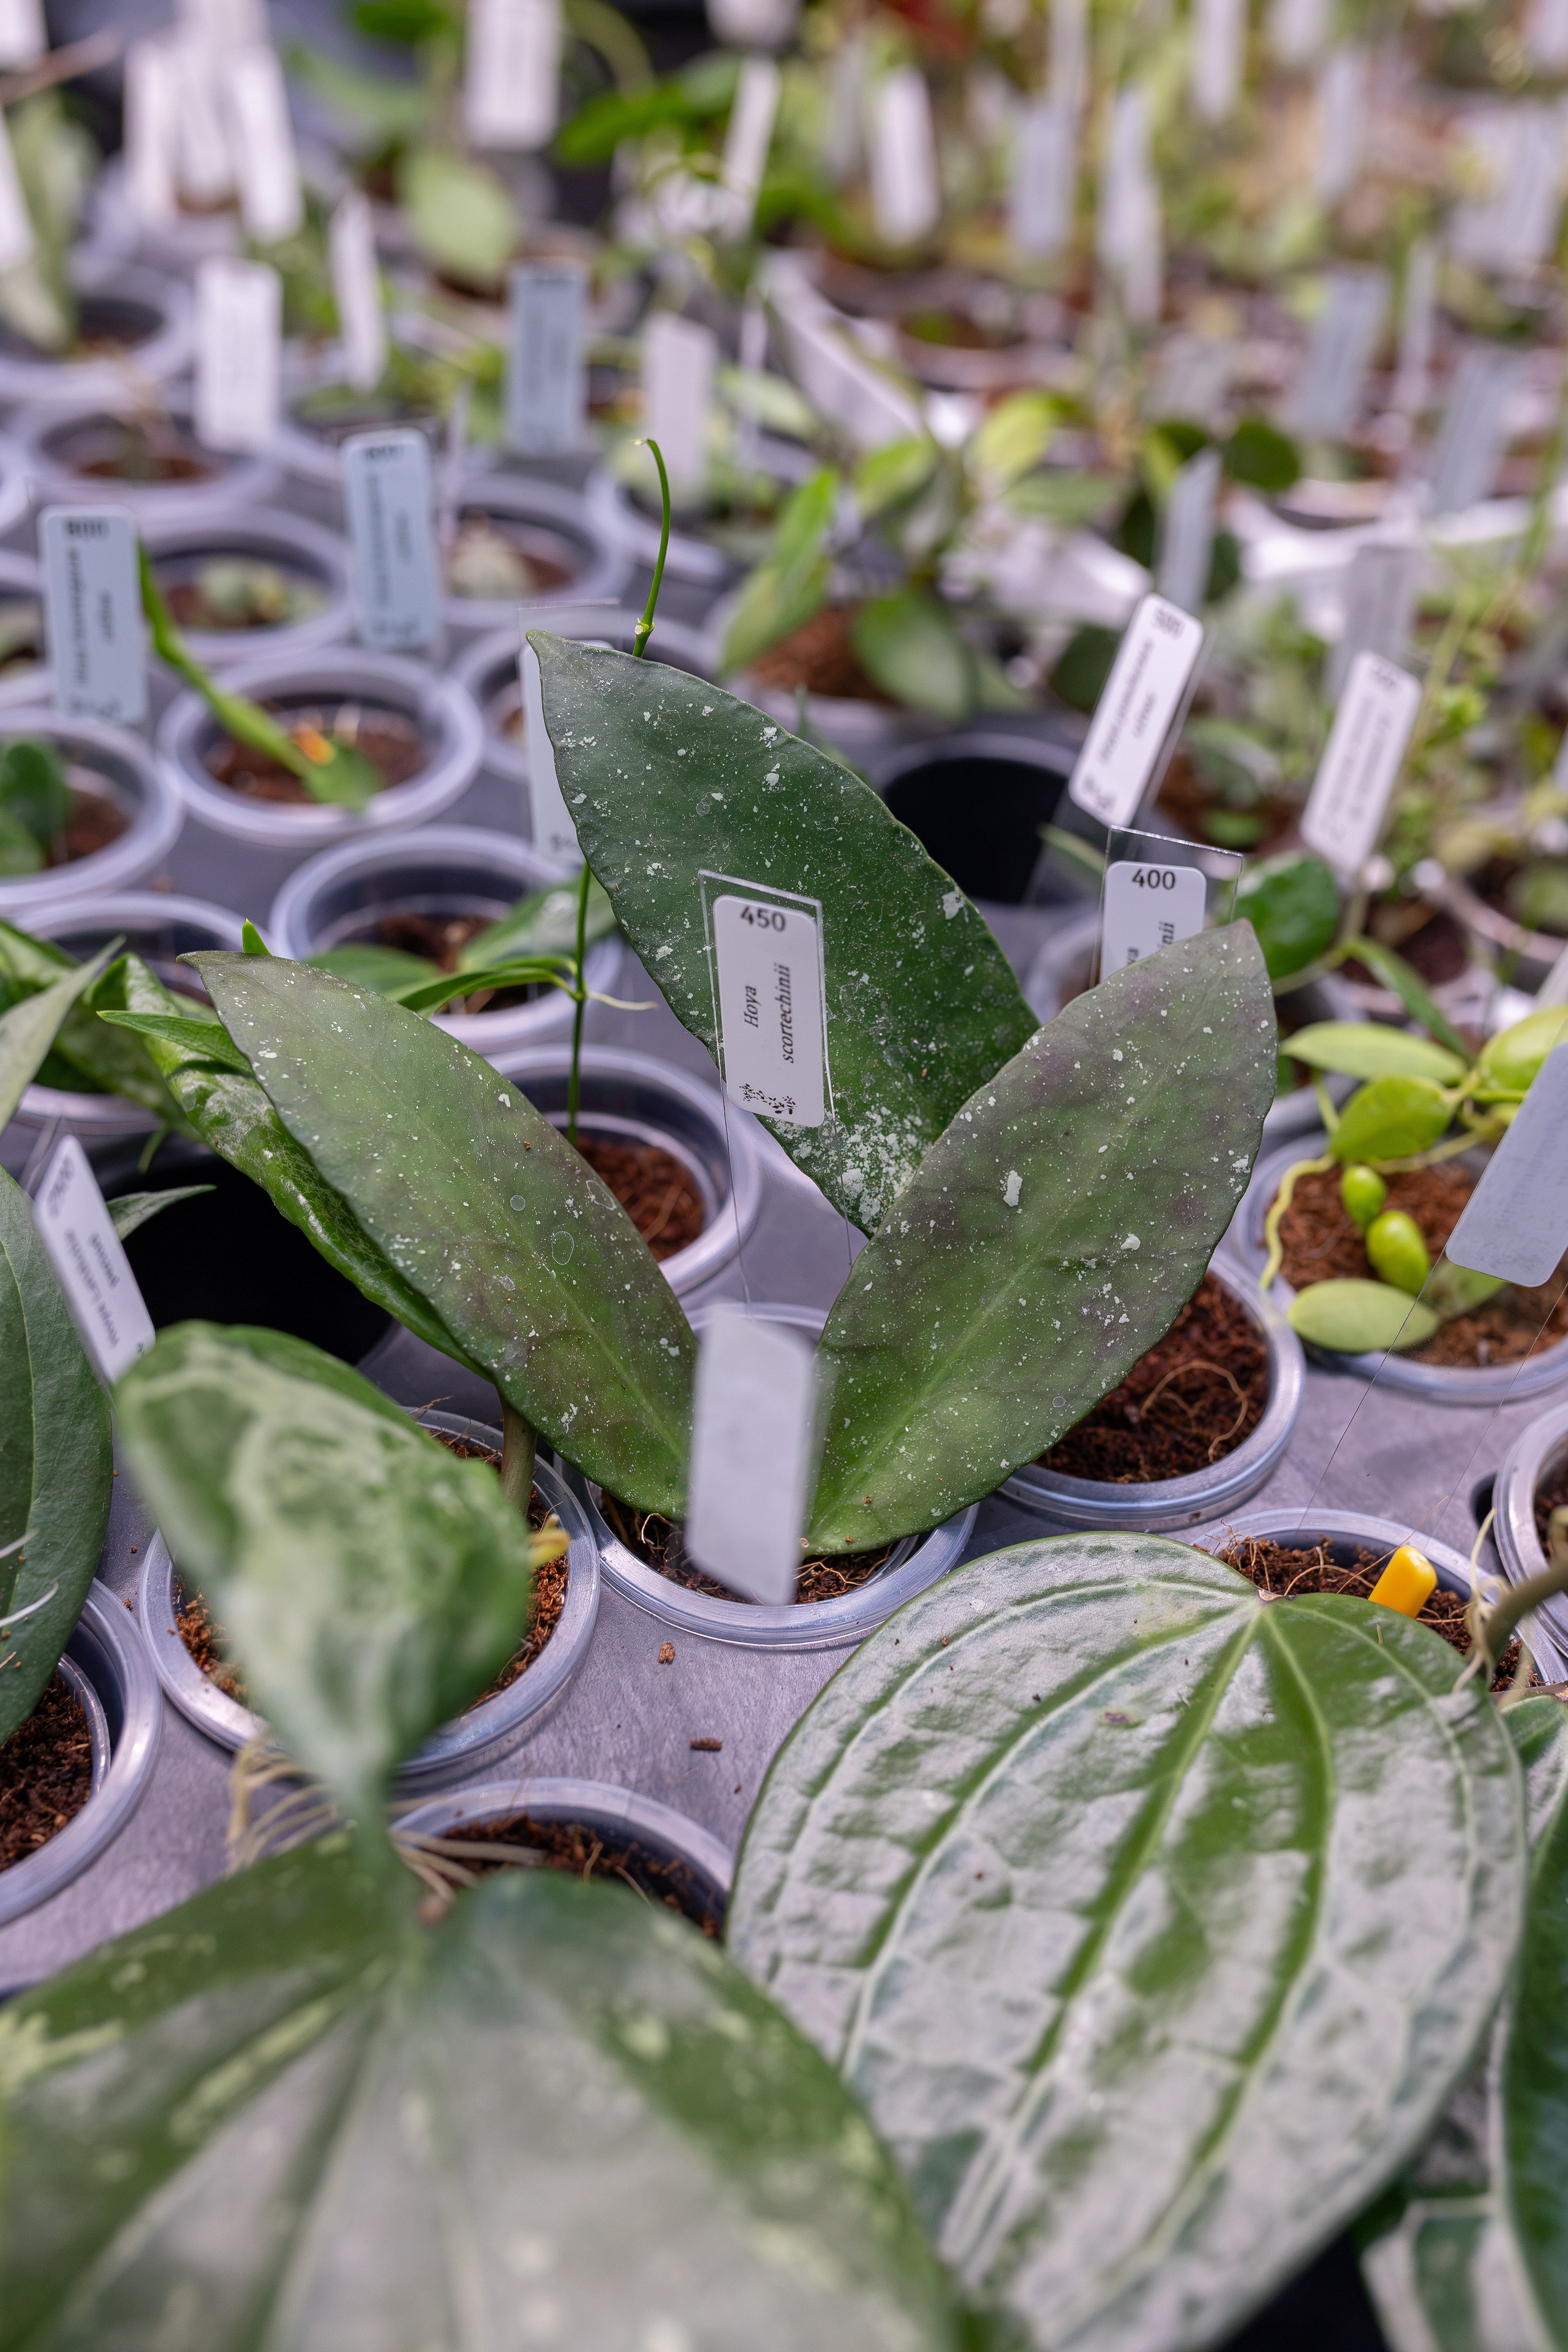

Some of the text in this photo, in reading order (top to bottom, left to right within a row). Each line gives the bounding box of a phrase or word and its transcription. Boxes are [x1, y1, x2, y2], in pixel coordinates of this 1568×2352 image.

[1132, 869, 1176, 890] 400
[739, 905, 787, 932] 450
[744, 985, 761, 1028] Hoya
[774, 962, 794, 1064] scortechinii
